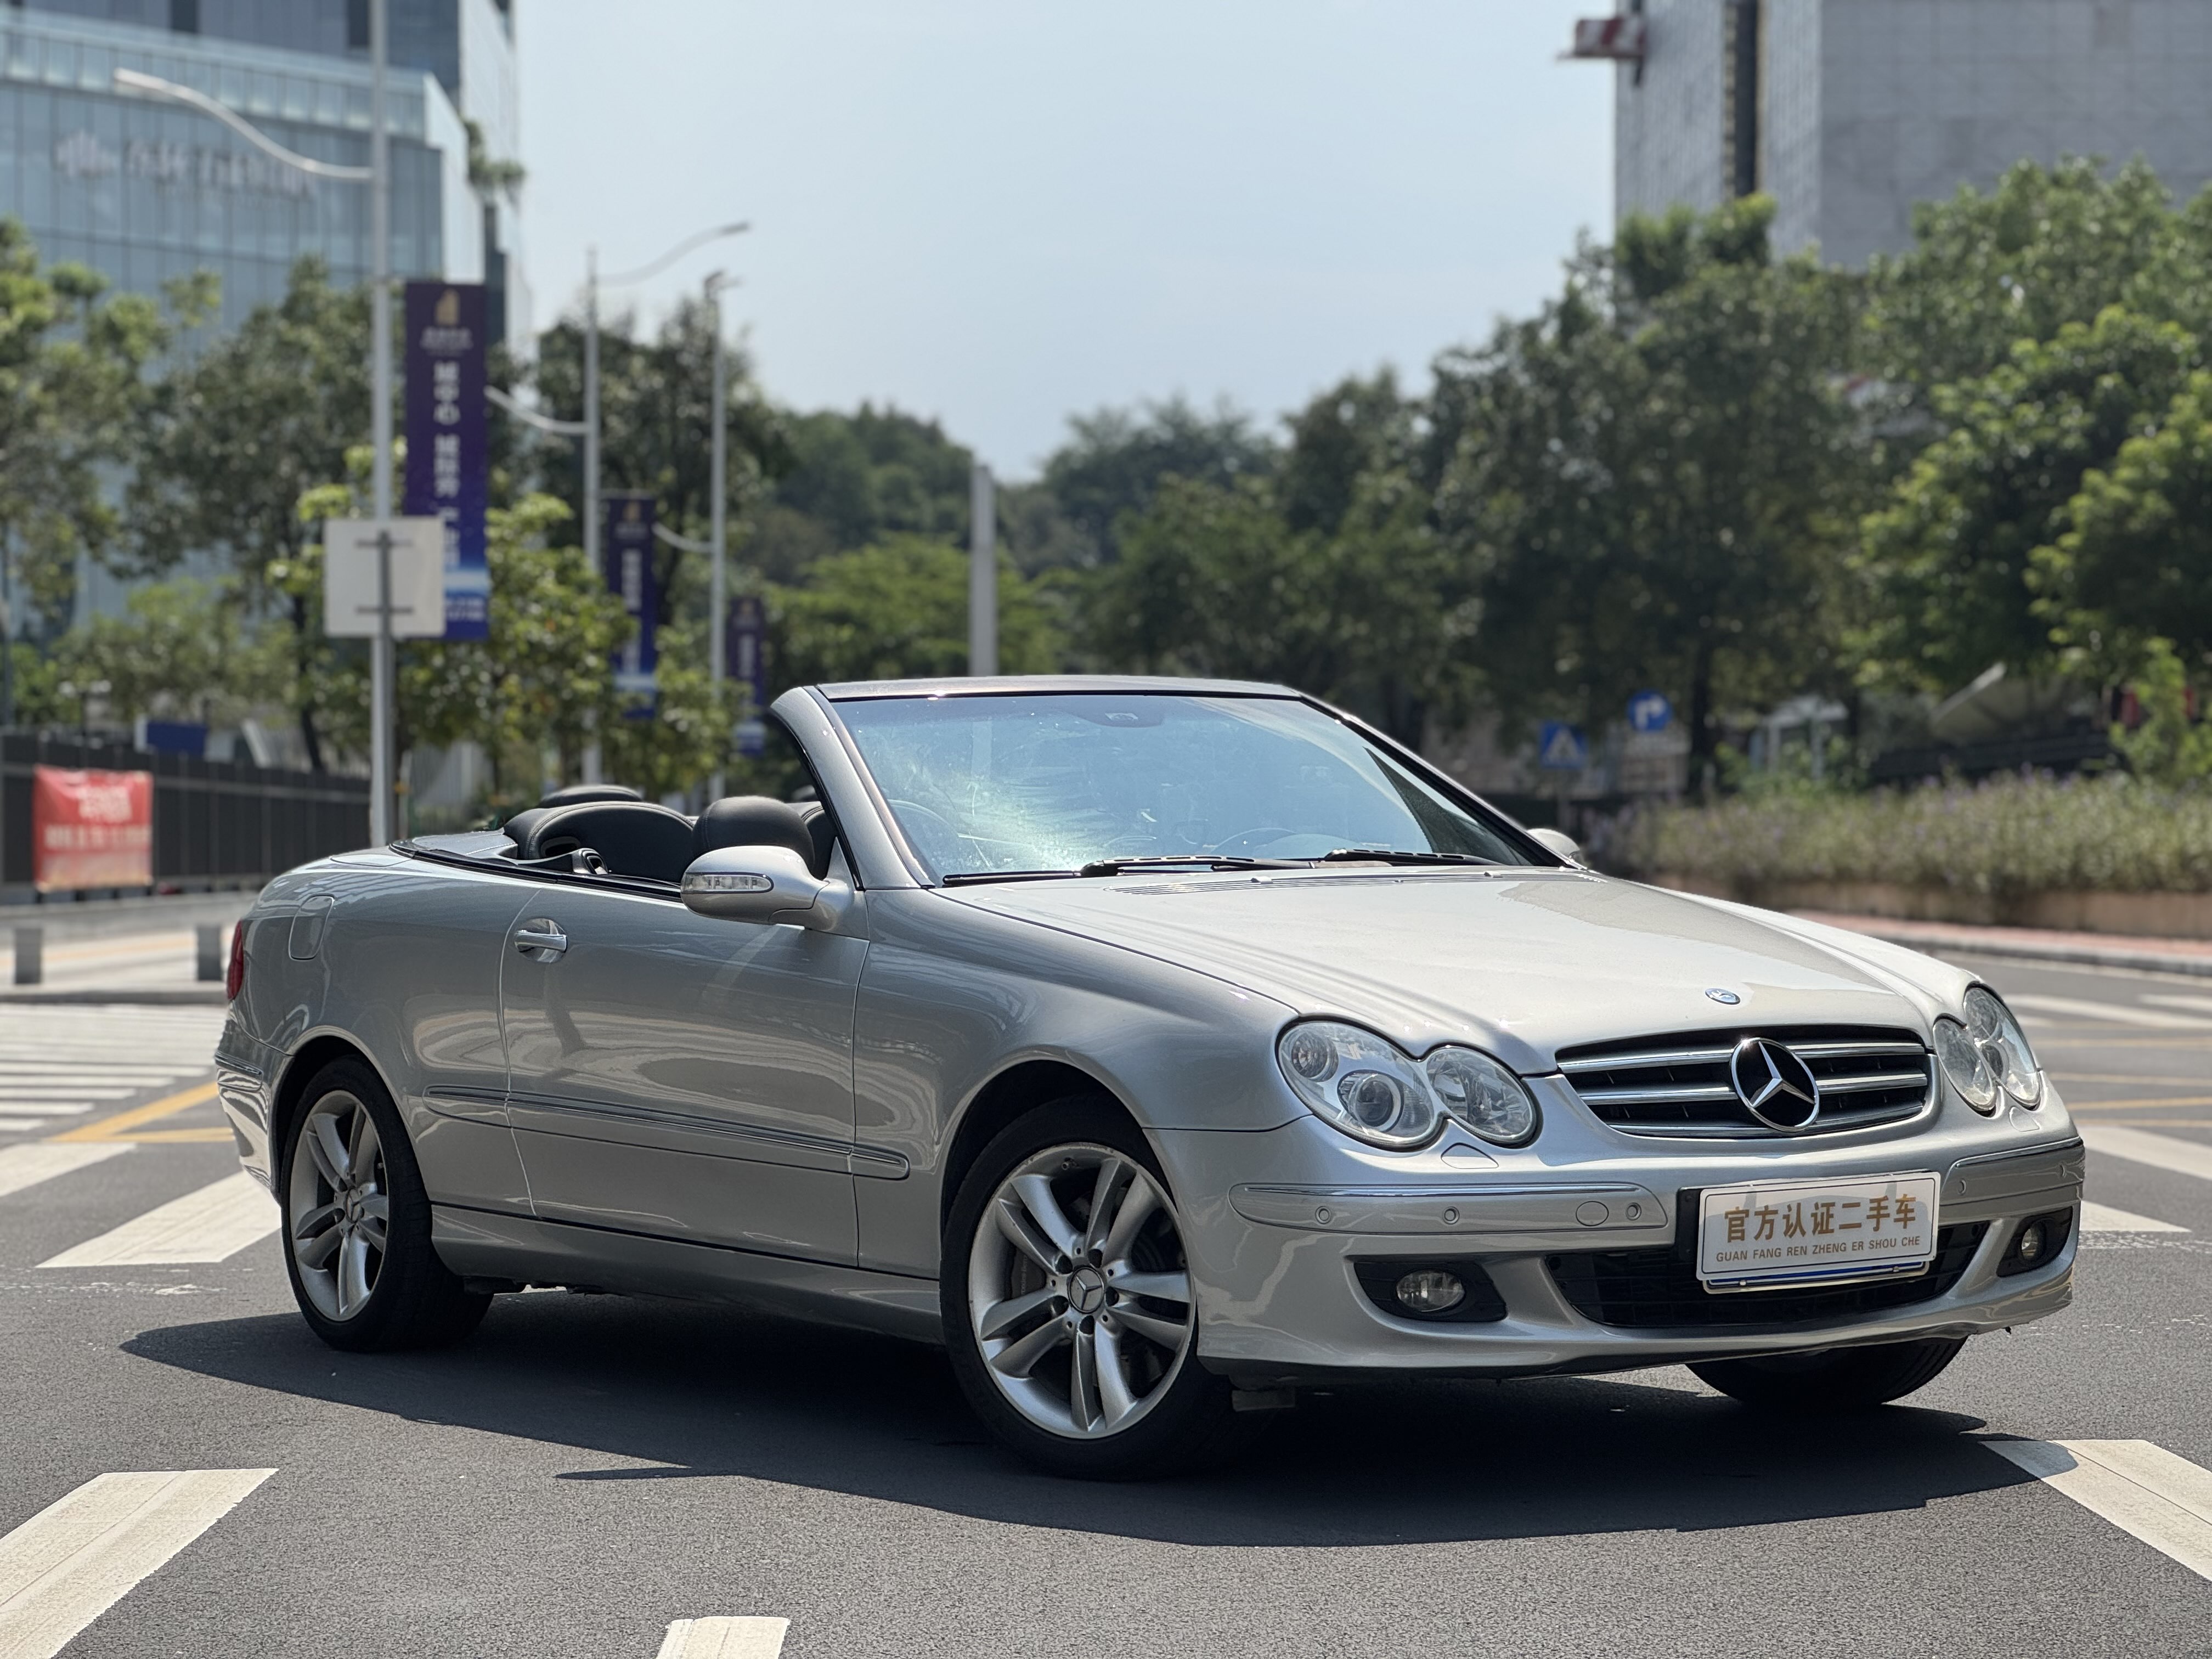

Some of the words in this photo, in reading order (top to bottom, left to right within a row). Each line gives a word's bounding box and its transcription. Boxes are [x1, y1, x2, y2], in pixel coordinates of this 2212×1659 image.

[1724, 1193, 1916, 1243] 官方认证二手车
[1716, 1250, 1748, 1262] GUAN
[1753, 1248, 1782, 1259] FANG
[1786, 1246, 1808, 1256] REN
[1812, 1243, 1847, 1255] ZHENG
[1852, 1241, 1864, 1251] ER
[1868, 1238, 1897, 1249] SHOU
[1901, 1235, 1921, 1246] CHE
